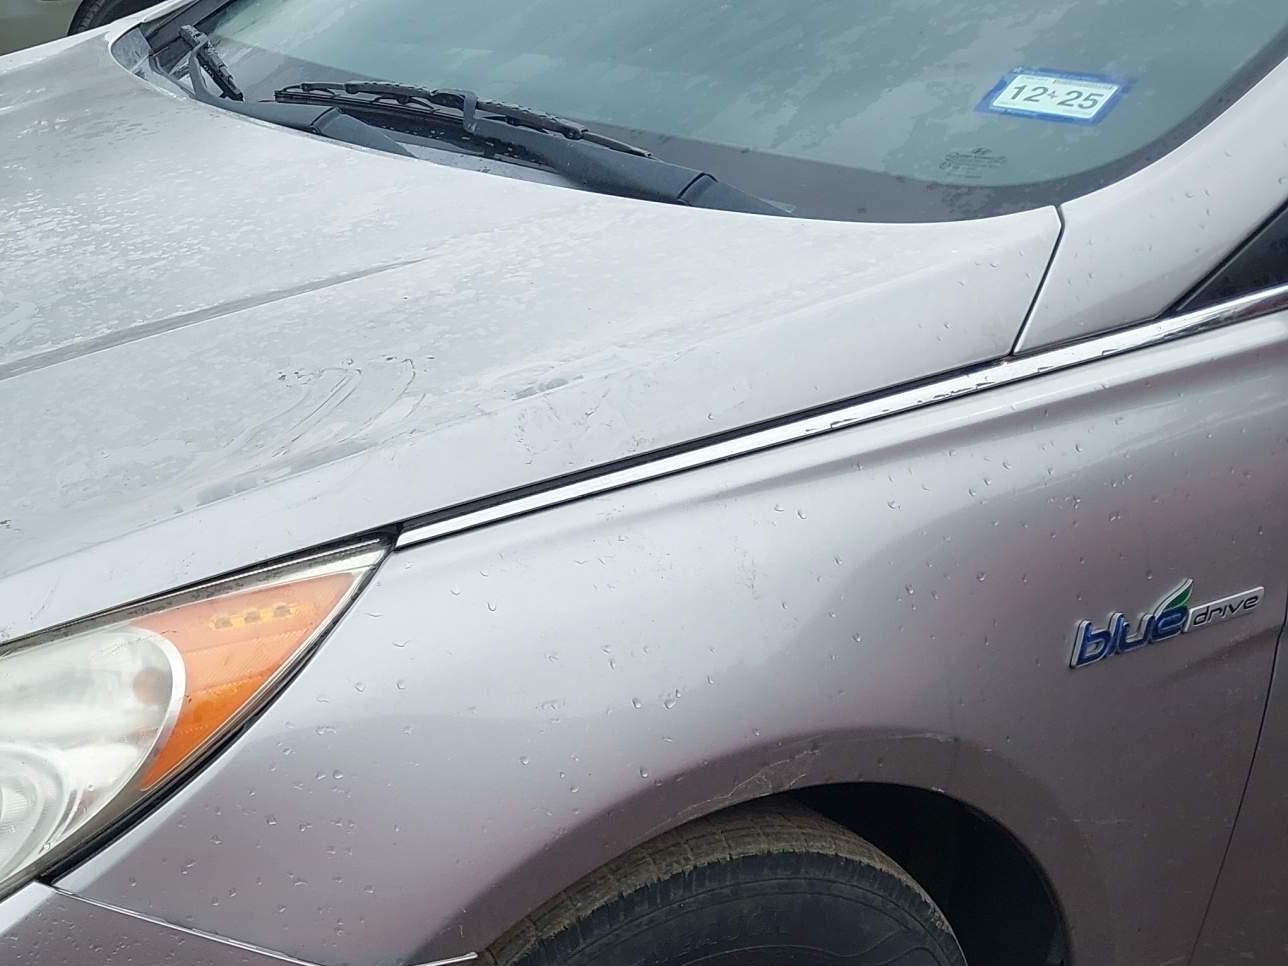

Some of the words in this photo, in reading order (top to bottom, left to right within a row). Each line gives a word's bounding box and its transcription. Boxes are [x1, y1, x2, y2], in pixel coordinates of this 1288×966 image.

[1010, 84, 1049, 103] 12
[1056, 90, 1105, 110] 25
[1068, 600, 1190, 668] blue
[1192, 594, 1259, 627] drive
